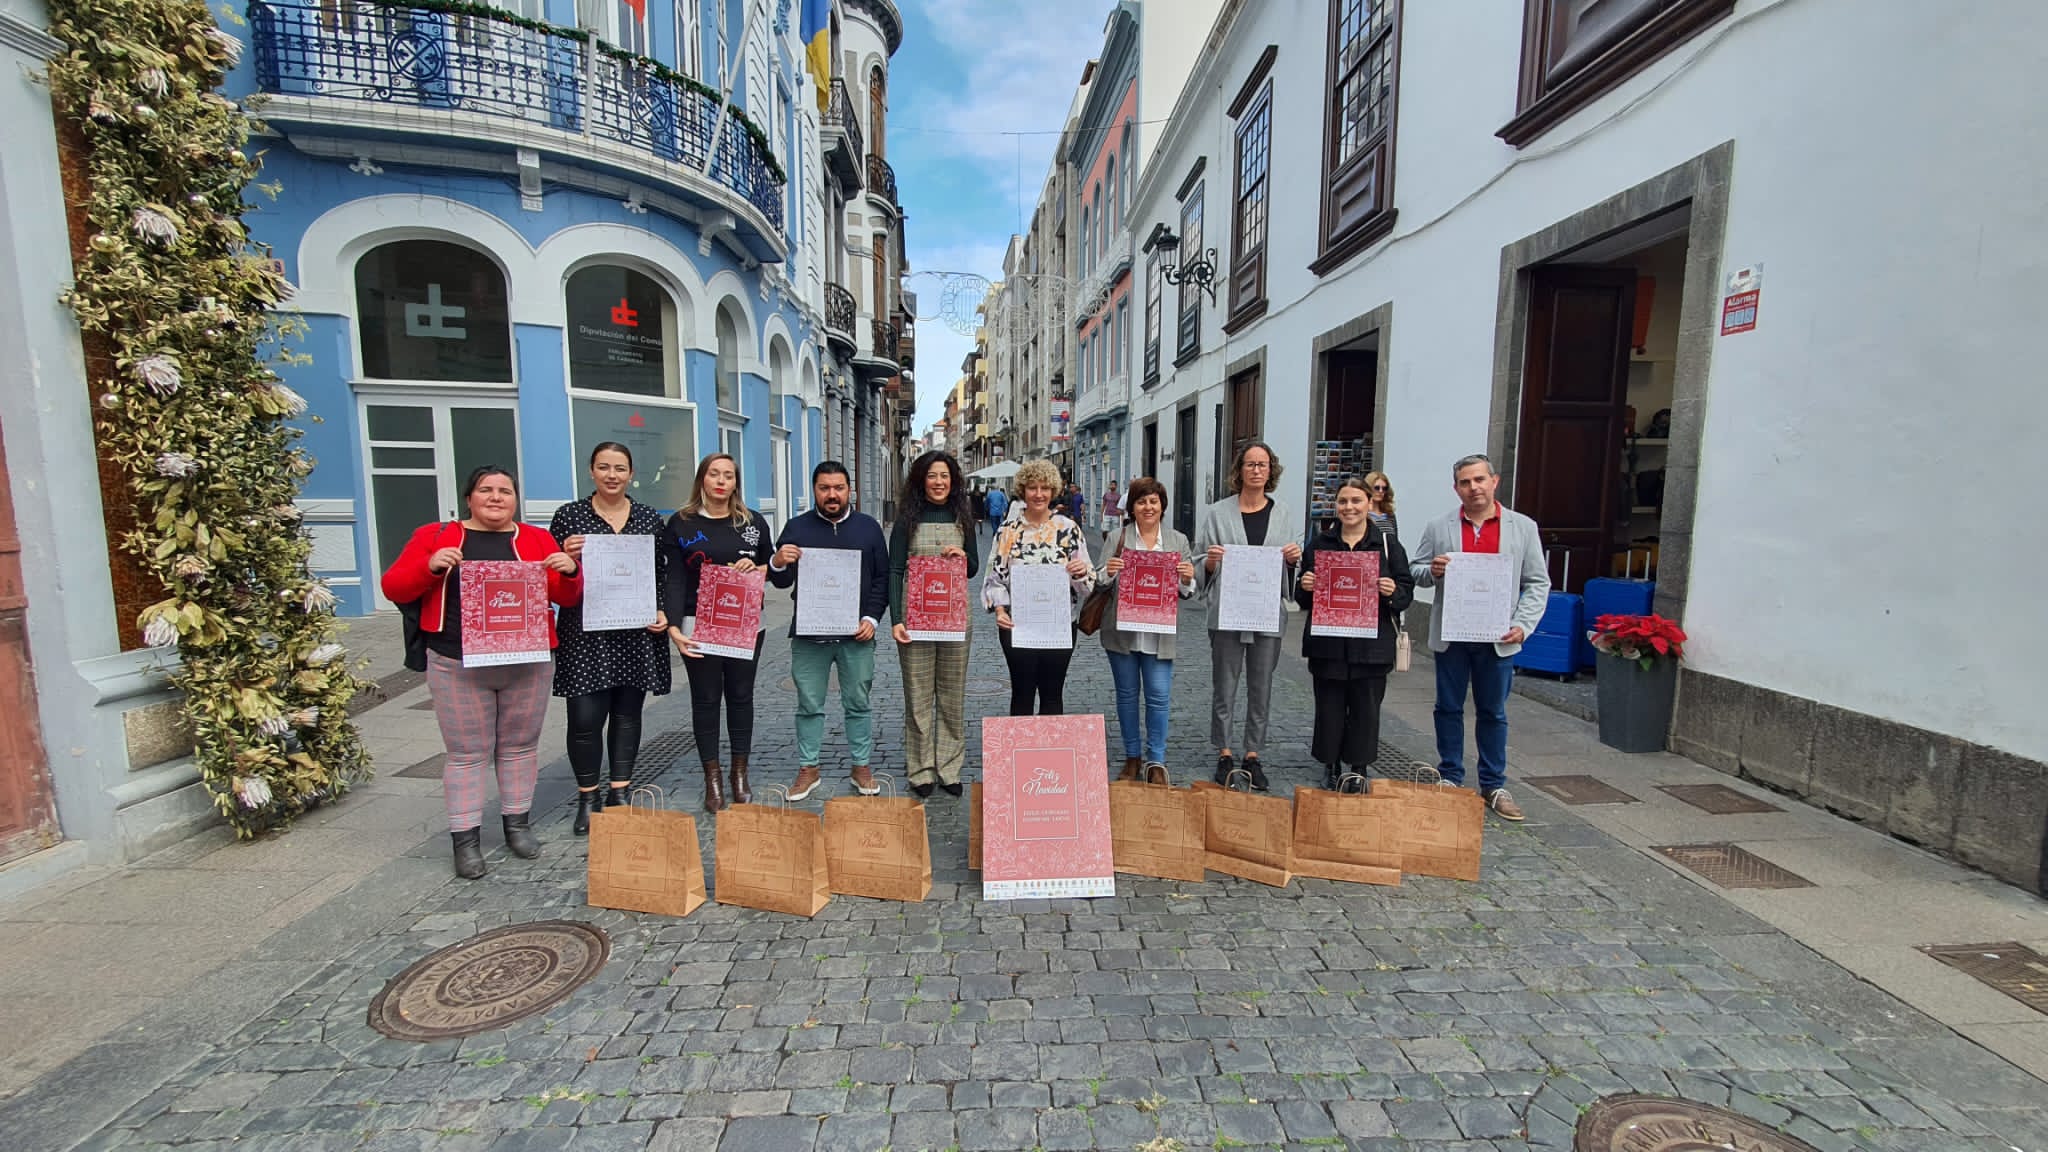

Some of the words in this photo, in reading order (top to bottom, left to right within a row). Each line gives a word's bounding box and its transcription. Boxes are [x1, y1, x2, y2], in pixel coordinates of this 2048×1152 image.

[1727, 294, 1757, 307] Alarma
[579, 325, 625, 340] Diputación
[1029, 767, 1060, 784] Feliz
[1022, 780, 1069, 796] Navidad
